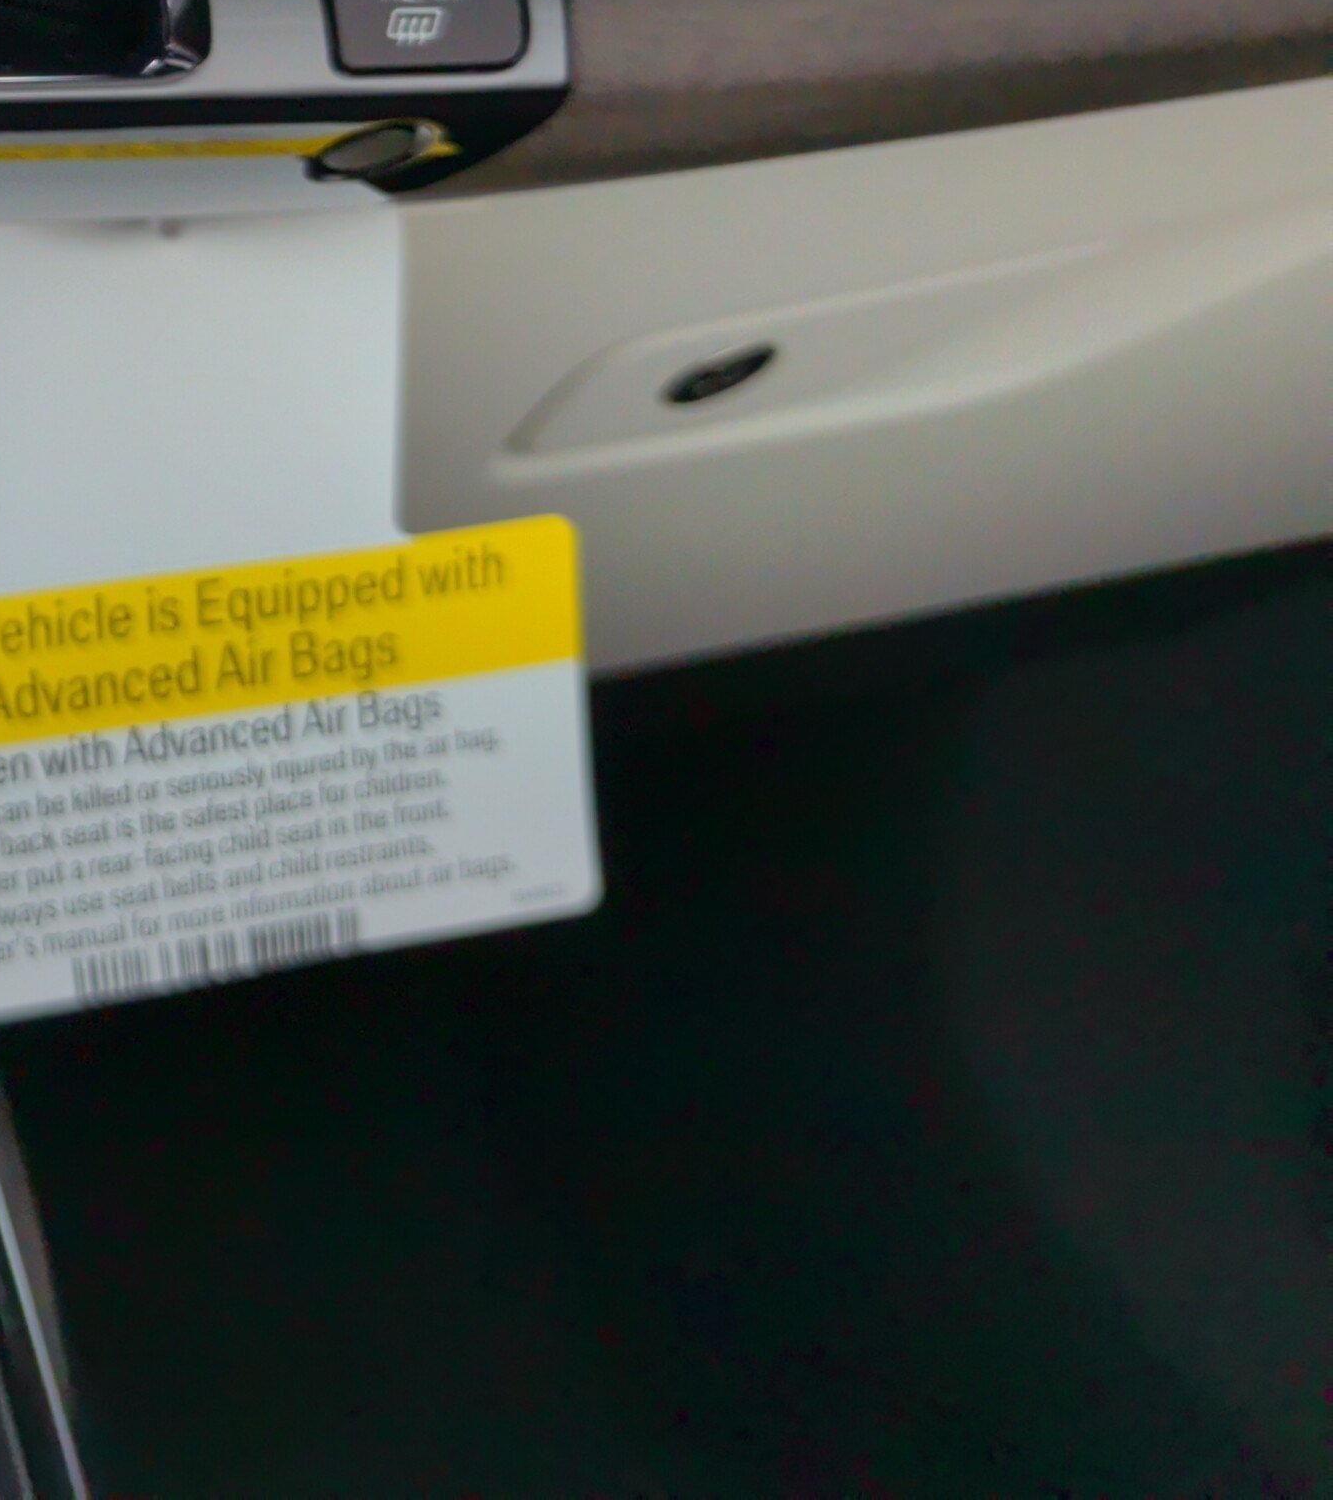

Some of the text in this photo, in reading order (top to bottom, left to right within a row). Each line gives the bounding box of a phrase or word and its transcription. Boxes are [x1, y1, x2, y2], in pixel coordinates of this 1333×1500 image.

[145, 586, 181, 634] is
[196, 554, 407, 630] Equipped
[417, 544, 505, 597] with
[215, 636, 273, 691] Air
[289, 630, 400, 681] Bags
[36, 790, 66, 817] be
[71, 780, 132, 812] killed
[137, 780, 159, 801] or
[165, 759, 265, 798] seriously
[271, 747, 347, 782] injured
[353, 743, 378, 771] by
[384, 734, 416, 760] the
[424, 732, 447, 755] air
[455, 727, 500, 753] bag.
[38, 733, 114, 778] with
[124, 702, 292, 766] Advanced
[302, 697, 345, 738] Air
[357, 689, 443, 731] Bags
[0, 823, 55, 857] back
[62, 819, 109, 847] seat
[114, 813, 135, 839] is
[139, 808, 176, 835] the
[182, 799, 247, 829] safest
[256, 786, 313, 821] place
[319, 779, 347, 804] for
[354, 767, 447, 800] children.
[26, 861, 65, 894] put
[88, 836, 212, 879] rear-facing
[218, 824, 270, 856] child
[277, 819, 323, 846] seat
[328, 812, 347, 838] in
[354, 806, 387, 831] the
[43, 915, 126, 951] manual
[132, 911, 161, 938] for
[168, 902, 226, 931] more
[231, 877, 355, 919] information
[362, 868, 422, 898] about
[427, 860, 452, 884] air
[64, 891, 105, 916] use
[110, 878, 157, 908] seat
[163, 869, 218, 899] belts
[223, 860, 263, 889] and
[268, 850, 320, 882] child
